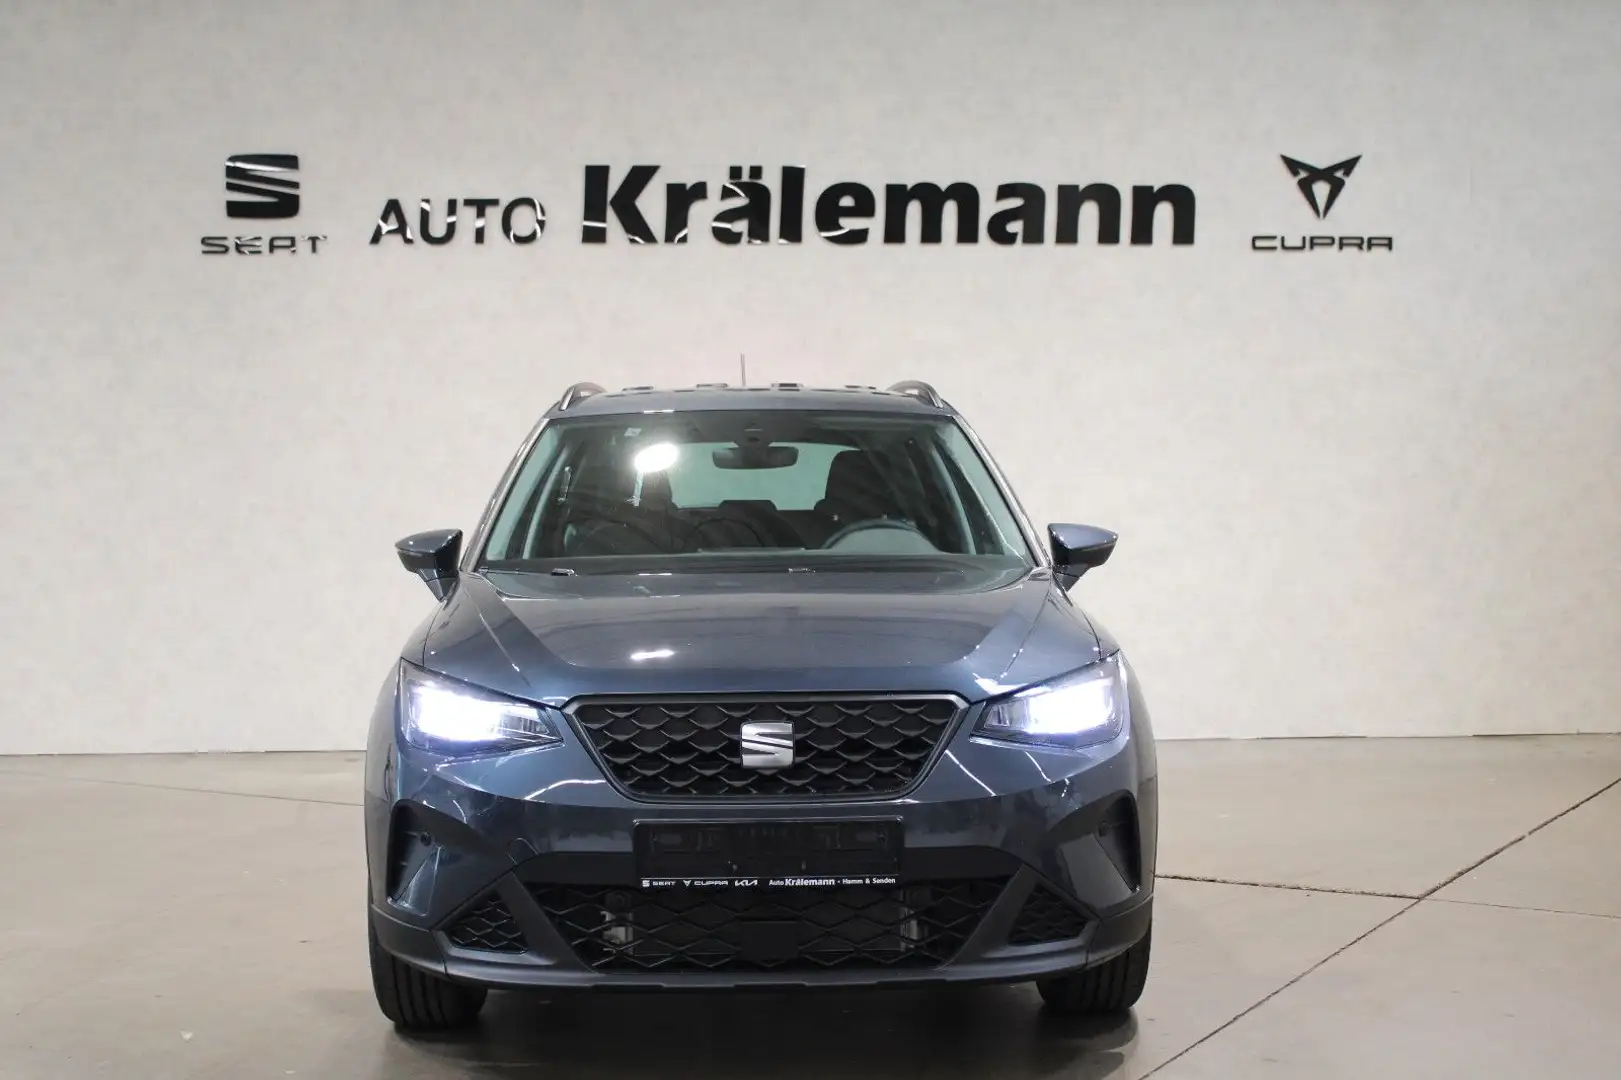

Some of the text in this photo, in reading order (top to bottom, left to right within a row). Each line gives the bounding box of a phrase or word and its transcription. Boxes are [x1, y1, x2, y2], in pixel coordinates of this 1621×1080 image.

[369, 164, 1197, 246] AUTO Krälemann
[200, 236, 327, 254] SEAT
[1251, 235, 1393, 252] CUPRA
[872, 877, 896, 885] Senden
